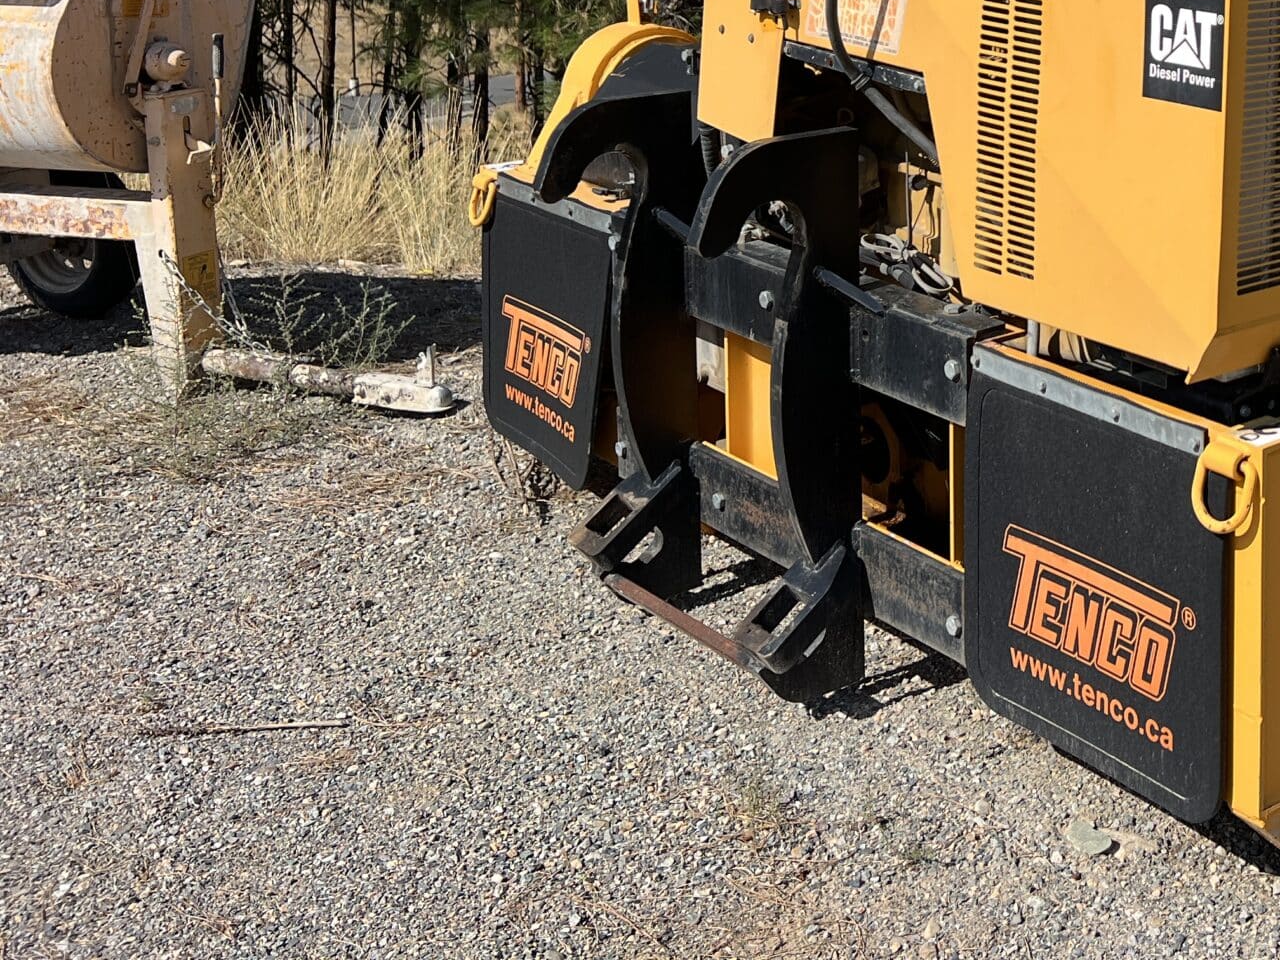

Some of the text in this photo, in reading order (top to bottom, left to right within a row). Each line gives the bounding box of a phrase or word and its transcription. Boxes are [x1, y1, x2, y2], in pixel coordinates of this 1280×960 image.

[1149, 63, 1216, 89] Diesel Power
[1150, 3, 1218, 70] CAT
[502, 294, 585, 409] TENCO
[505, 383, 576, 443] www.tenco.ca
[1002, 523, 1180, 702] TENCO
[1010, 647, 1174, 752] www.tenco.ca
